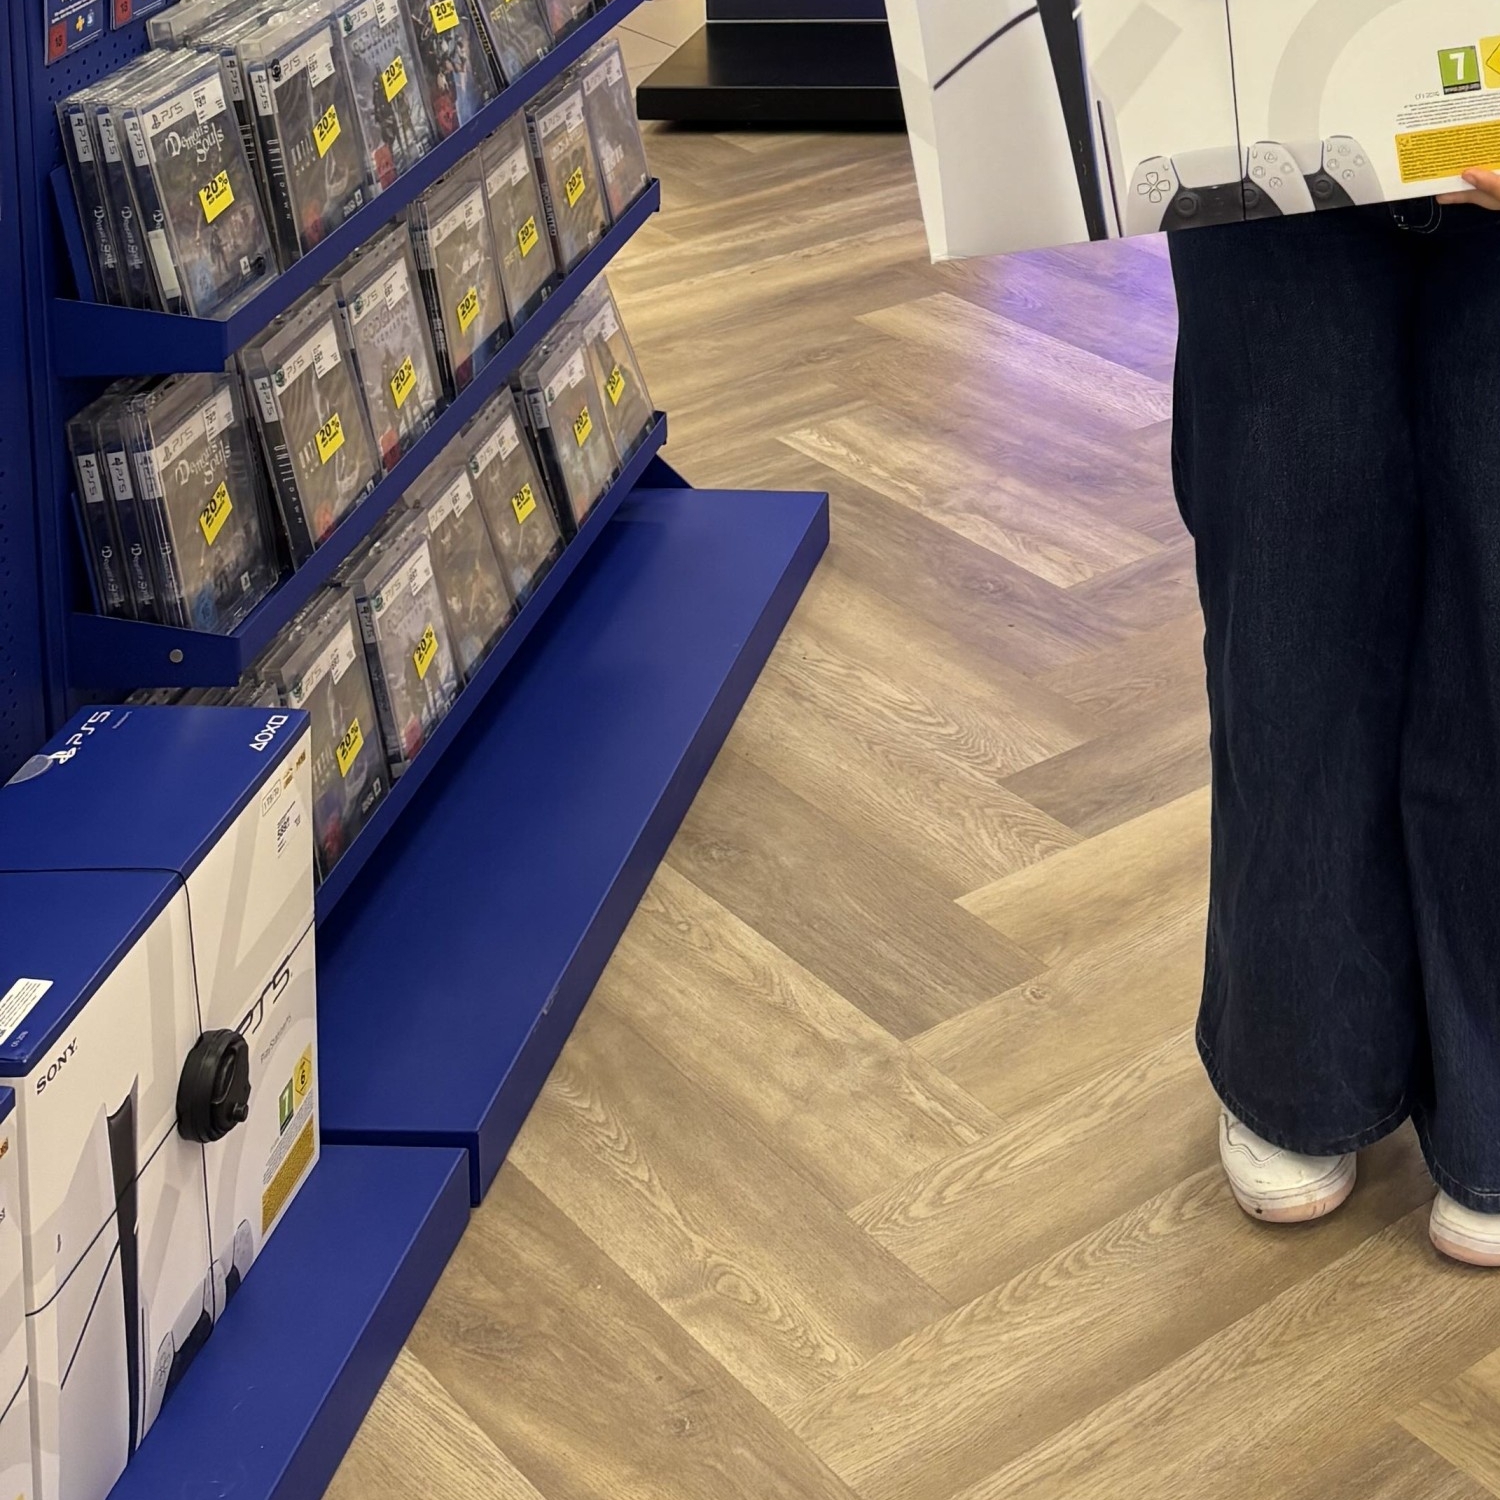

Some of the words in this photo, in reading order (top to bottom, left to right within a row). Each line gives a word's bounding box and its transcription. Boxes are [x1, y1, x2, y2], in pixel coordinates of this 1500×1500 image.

[434, 2, 455, 17] 20%
[385, 60, 403, 84] 20%
[1449, 51, 1465, 81] 7
[161, 101, 184, 123] PS5
[317, 108, 336, 137] 20%
[197, 122, 225, 164] Souls
[203, 174, 229, 201] 20%
[459, 290, 478, 316] 20%
[285, 355, 304, 380] PS5
[393, 362, 412, 390] 20%
[172, 426, 194, 451] PS5
[318, 417, 341, 444] 20%
[203, 487, 226, 526] 20%
[514, 486, 532, 508] 20%
[415, 630, 434, 660] 20%
[66, 710, 111, 746] PS5
[339, 725, 360, 757] 20%
[36, 1037, 78, 1095] SONY
